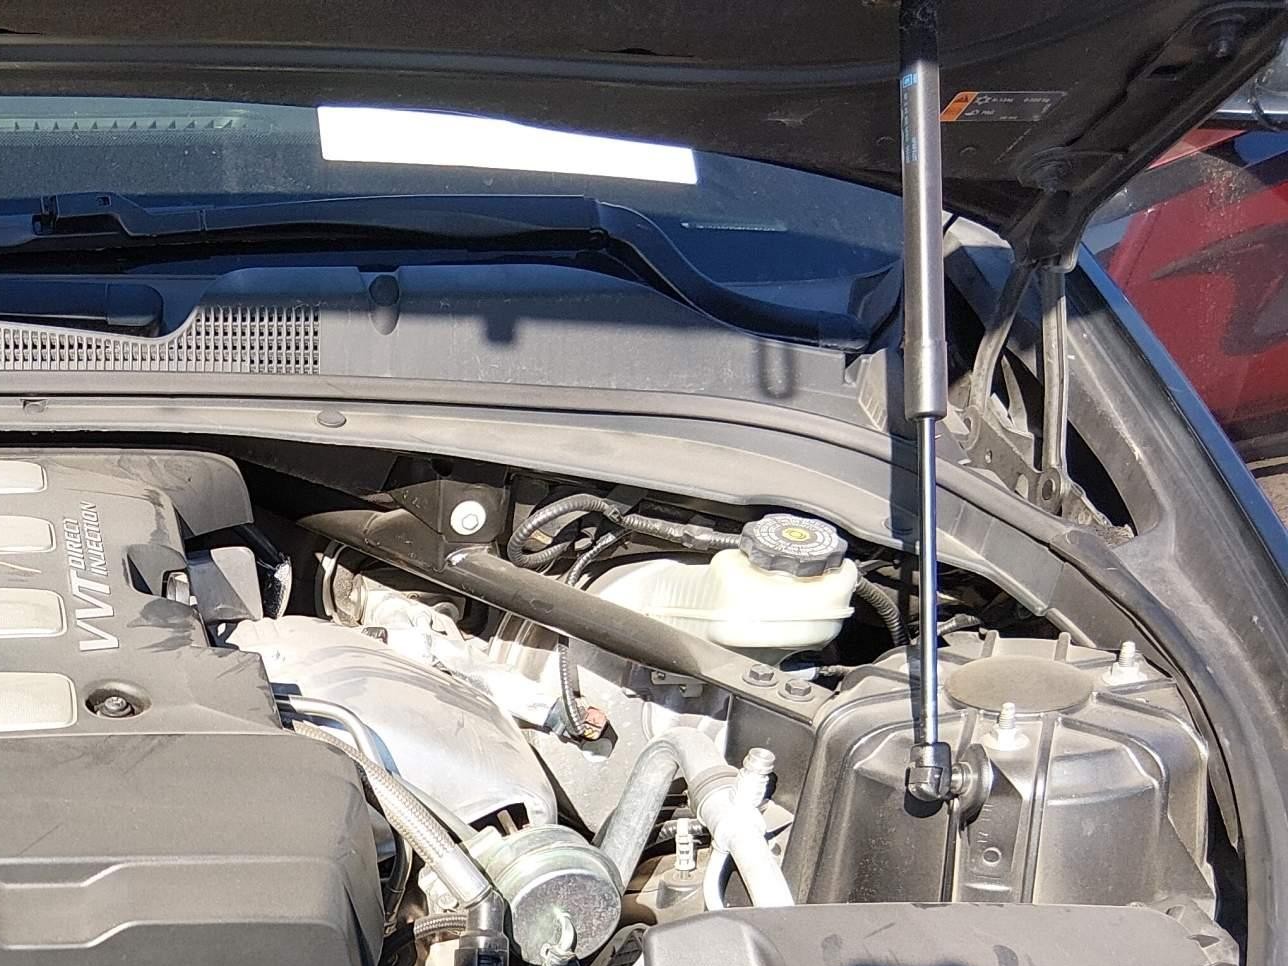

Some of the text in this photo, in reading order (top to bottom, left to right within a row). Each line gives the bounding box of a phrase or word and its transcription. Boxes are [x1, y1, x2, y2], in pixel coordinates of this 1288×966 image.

[63, 517, 86, 570] DIRECT
[80, 500, 108, 577] INJECTION
[69, 569, 119, 652] VVT
